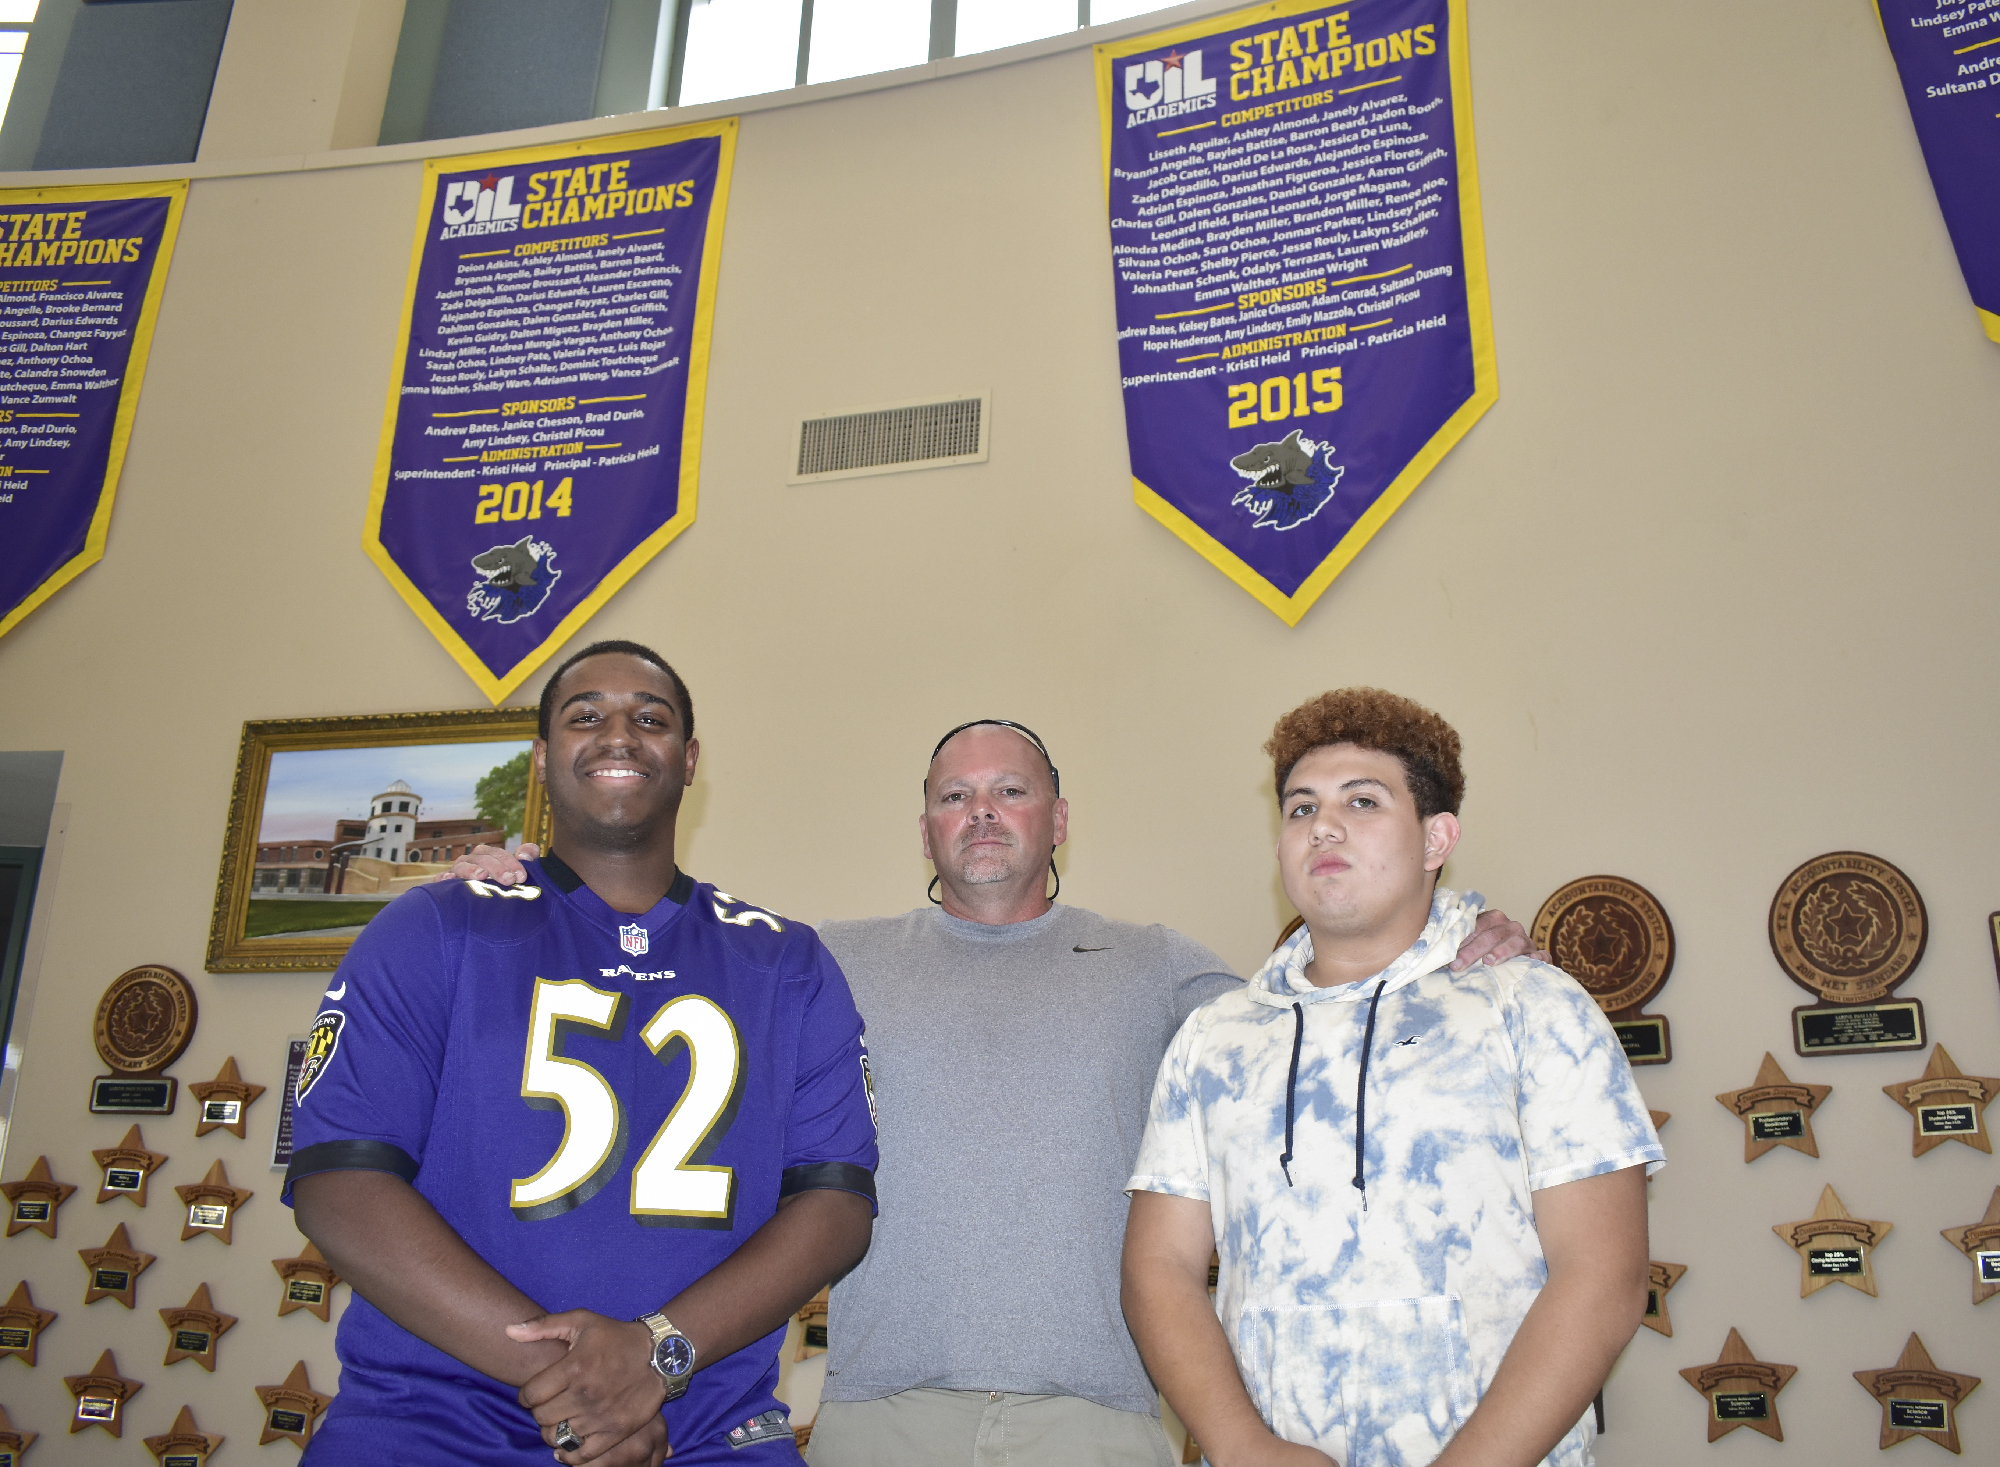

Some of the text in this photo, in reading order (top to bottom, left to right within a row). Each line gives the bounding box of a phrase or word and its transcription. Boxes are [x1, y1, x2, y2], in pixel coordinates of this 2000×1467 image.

[1911, 8, 1965, 28] Lindsey
[1943, 17, 1987, 38] Emma
[1230, 11, 1352, 72] STATE
[1230, 24, 1437, 101] CHAMPIONS
[1926, 79, 1987, 98] Sultana
[1126, 93, 1217, 129] ACADEMICS
[1221, 90, 1334, 128] COMPETITORS
[1148, 93, 1408, 162] Lisseth Aguilar, Ashley Almond, Janely Alvarez,
[1131, 132, 1429, 204] Zade Delgadillo, Darius Edwards, Alejandro Espinoza,
[1147, 121, 1412, 190] Jacob Cater, Harold De La Rosa, Jessica De Luna,
[526, 160, 631, 202] STATE
[1137, 147, 1424, 217] Adrian Espinoza, Jonathan Figueroa, Jessica Flores,
[521, 179, 695, 229] CHAMPIONS
[1150, 179, 1411, 242] Leonard Ifield, Briana Leonard, Jorge Magana,
[440, 217, 519, 240] ACADEMICS
[513, 233, 609, 258] COMPETITORS
[0, 237, 143, 267] HAMPIONS
[457, 241, 665, 274] Deion Adkins, Ashley Almond, Janely Alvarez,
[454, 253, 665, 286] Bryanna Angelle, Bailey Battise, Barron Beard,
[1194, 256, 1368, 302] Emma Walther, Maxine Wright
[3, 302, 123, 317] Angelle, Brooke Bernard
[38, 291, 85, 301] Francisco
[85, 291, 124, 300] Alvarez
[440, 278, 673, 311] Zade Delgadillo, Darius Edwards, Lauren Escareno,
[1238, 278, 1327, 309] SPONSORS
[42, 315, 118, 327] Darius Edwards
[1142, 288, 1420, 352] Hope Henderson, Amy Lindsey, Emily Mazzola, Christel Picou
[8, 341, 88, 353] Gill, Dalton Hart
[1122, 315, 1447, 388] Superintendent Kristi Heid Principal Patricia Heid
[1222, 323, 1347, 360] ADMINISTRATION
[13, 367, 107, 378] Calandra Snowden
[0, 394, 77, 404] Vance Zumwalt
[501, 396, 576, 417] SPONSORS
[1228, 366, 1343, 429] 2015
[423, 410, 645, 436] Andrew Bates, Janice Chesson, Brad Durio,
[461, 427, 605, 449] Amy Lindsey, Christel Picou
[480, 441, 583, 463] ADMINISTRATION
[474, 477, 573, 524] 2014
[1549, 882, 1639, 918] ACCOUNTABILITY
[1640, 898, 1666, 942] SYSTEM
[1886, 876, 1918, 919] SYSTEM
[625, 935, 645, 950] NFL
[598, 964, 676, 981] RAVENS
[1821, 976, 1848, 990] MET
[1856, 954, 1909, 991] STANDARD
[1606, 972, 1657, 1008] STANDARD
[510, 976, 743, 1222] 52
